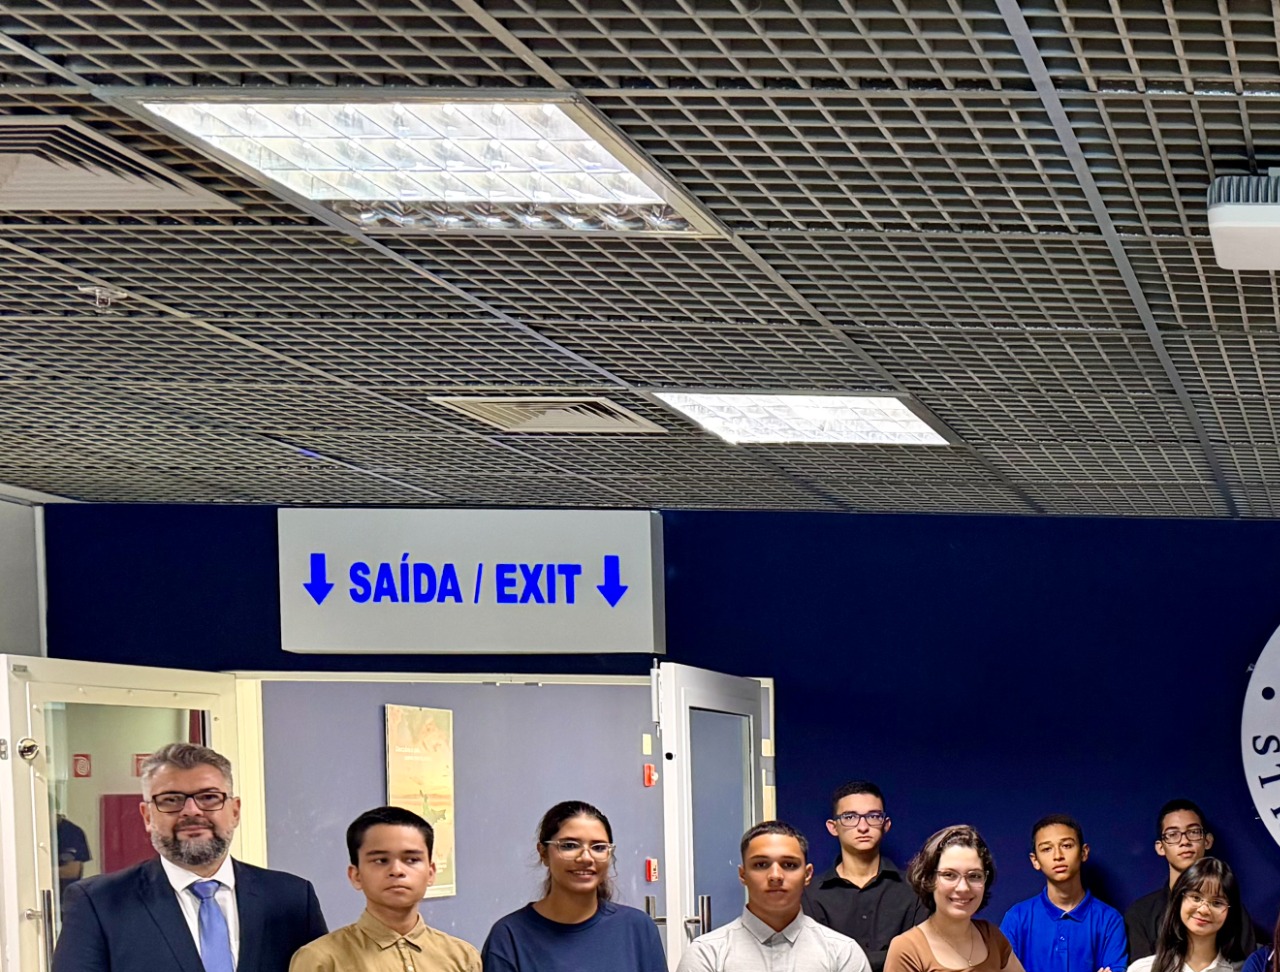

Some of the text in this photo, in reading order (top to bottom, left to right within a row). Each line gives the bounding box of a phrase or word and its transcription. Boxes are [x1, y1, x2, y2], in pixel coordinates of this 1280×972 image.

[349, 553, 582, 604] SAÍDA / EXIT
